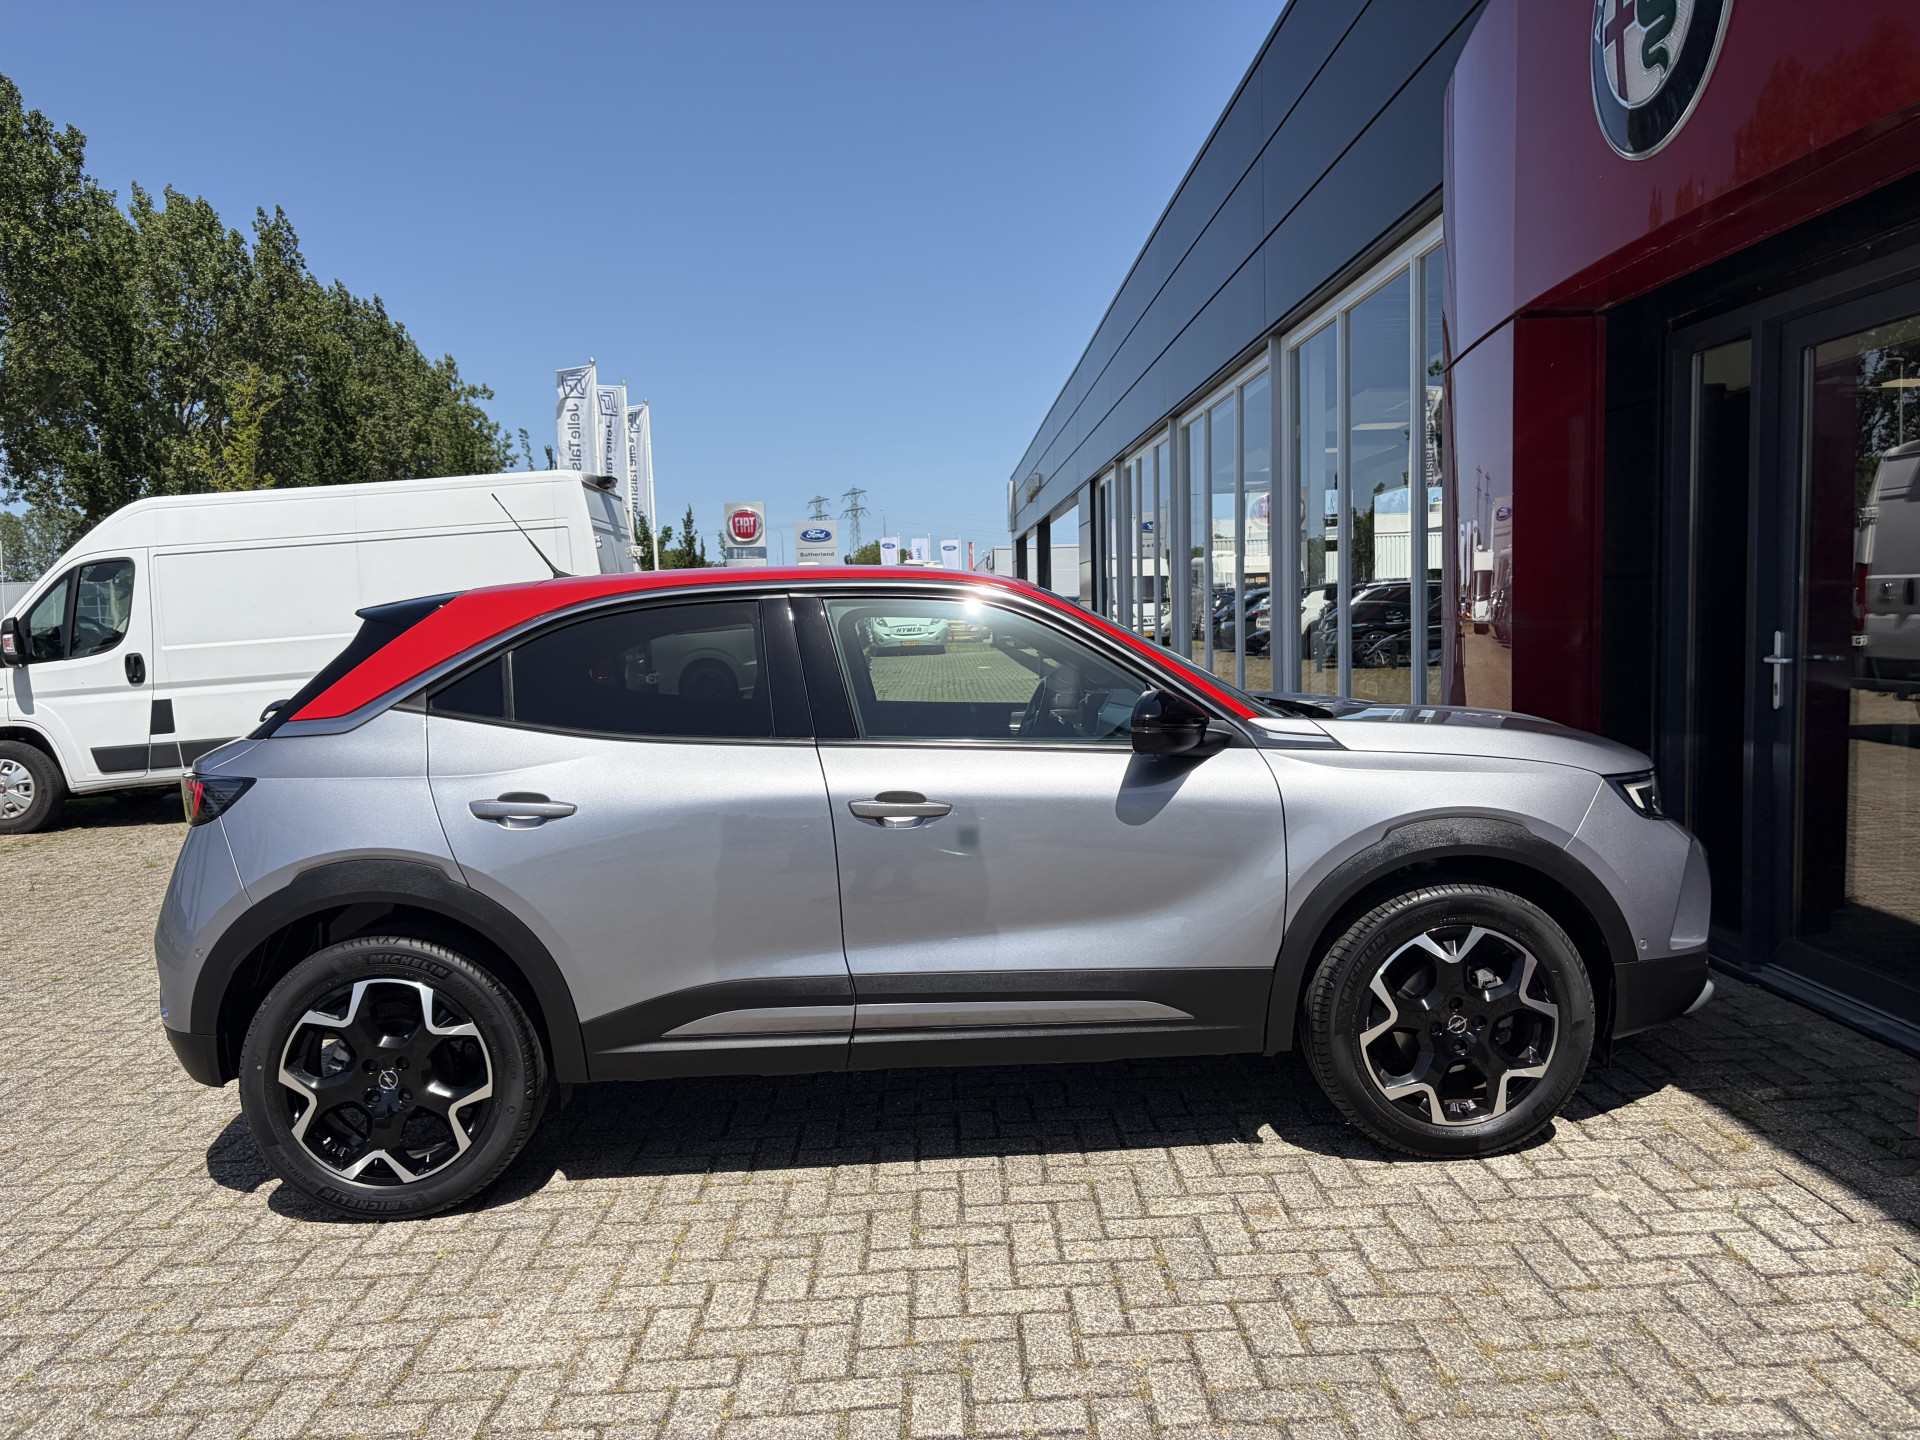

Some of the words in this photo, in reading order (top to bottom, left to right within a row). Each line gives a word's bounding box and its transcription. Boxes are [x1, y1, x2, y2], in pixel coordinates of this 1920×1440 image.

[734, 517, 755, 533] FIAT
[806, 529, 826, 539] Ford
[368, 953, 449, 977] MICHELIN
[1341, 932, 1388, 1002] MICHELIN
[320, 1185, 400, 1212] MICHELIN
